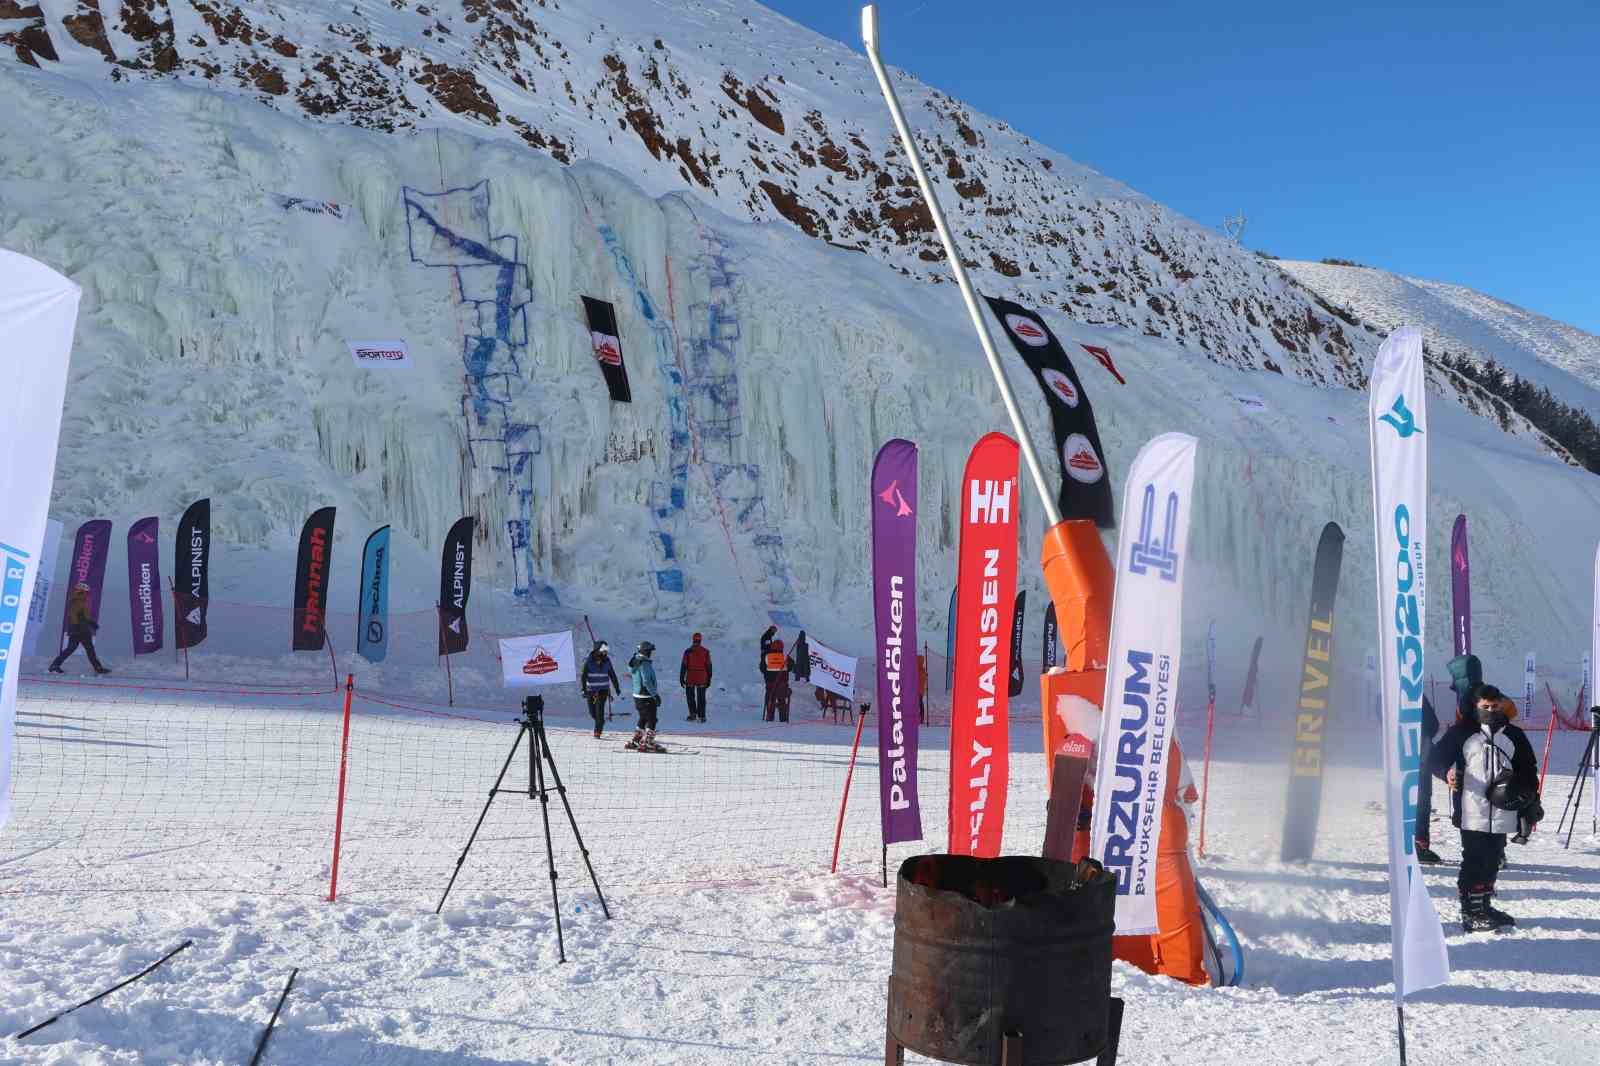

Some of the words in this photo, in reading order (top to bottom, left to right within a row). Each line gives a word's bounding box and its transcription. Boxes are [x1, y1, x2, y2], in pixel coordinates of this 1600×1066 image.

[138, 562, 155, 644] Palandöken
[191, 526, 203, 599] ALPINIST
[453, 542, 465, 609] ALPINIST
[886, 575, 910, 812] Palandöken
[976, 549, 1000, 727] HANSEN
[1295, 609, 1334, 777] GRIVEL
[968, 740, 993, 855] ELLY
[1063, 740, 1085, 753] elan
[1103, 649, 1153, 895] ERZURUM
